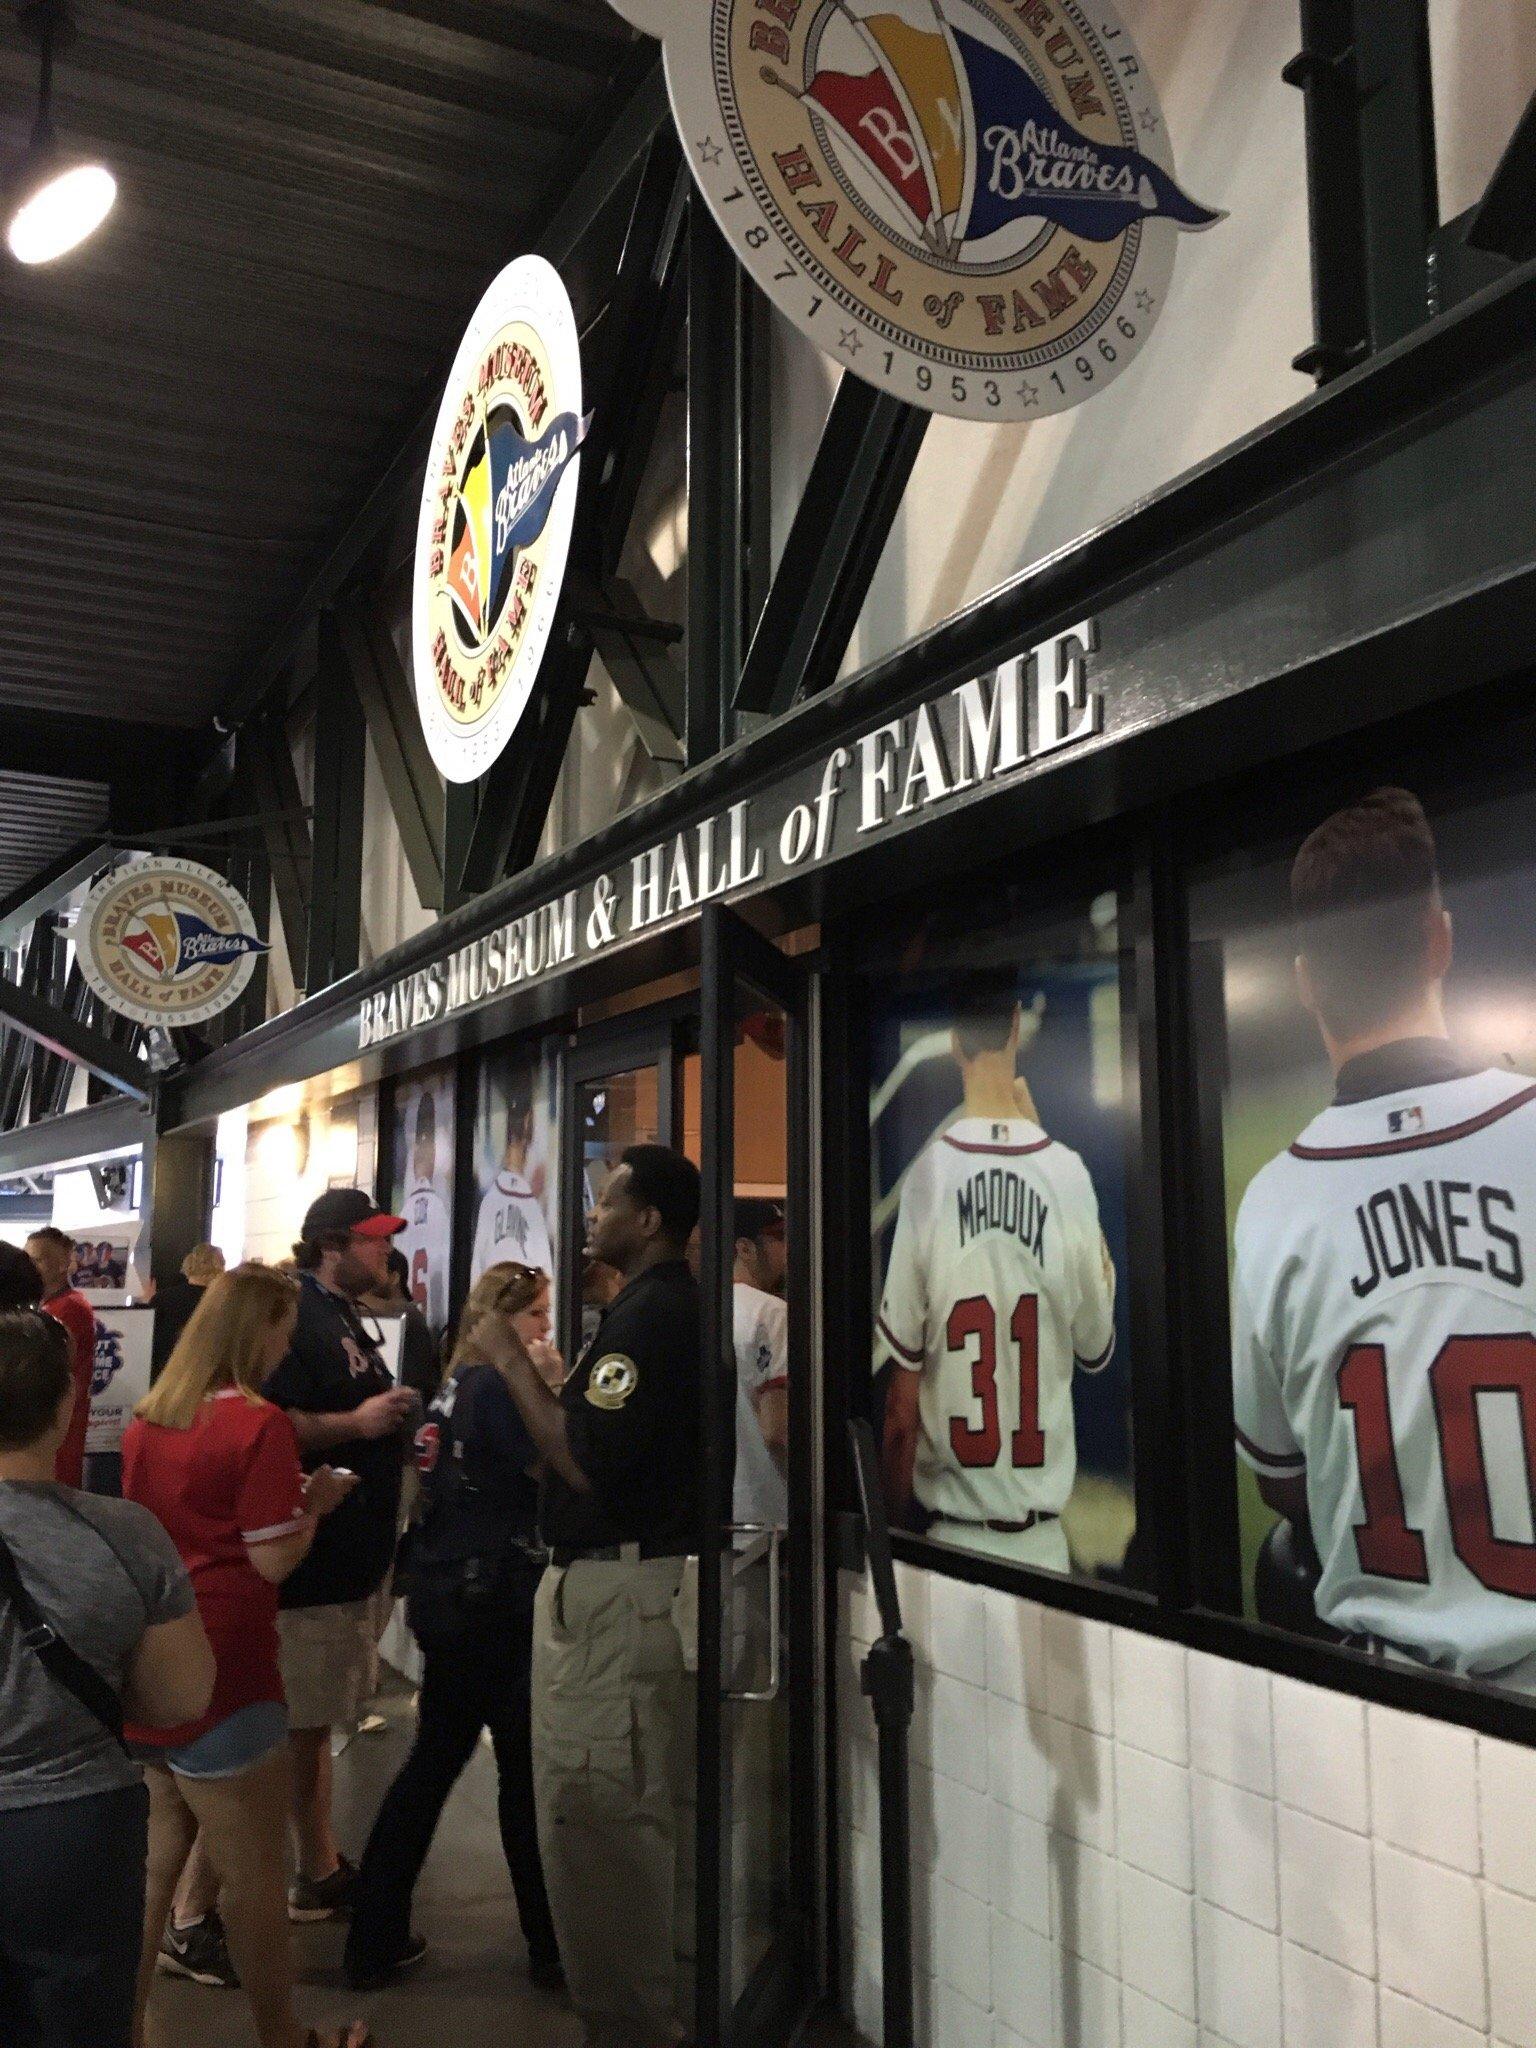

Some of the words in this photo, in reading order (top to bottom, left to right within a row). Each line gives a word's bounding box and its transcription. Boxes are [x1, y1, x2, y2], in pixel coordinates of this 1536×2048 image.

[859, 106, 922, 181] B
[983, 125, 1134, 200] Braves
[1021, 118, 1098, 164] Atlanta
[723, 186, 823, 317] 1871
[883, 351, 1001, 406] 1953
[1051, 315, 1136, 394] 1966
[771, 143, 904, 307] HALL
[923, 291, 965, 329] of
[976, 244, 1098, 335] FAME
[429, 391, 475, 578] BRAVES
[477, 341, 548, 430] MUSEUM
[431, 626, 466, 713] HALL
[486, 556, 538, 691] FAME
[459, 551, 478, 601] B
[358, 962, 445, 1049] BRAVES
[446, 889, 575, 1012] MUSEUM
[587, 874, 617, 950] &
[628, 800, 761, 932] HALL
[779, 747, 854, 866] of
[857, 619, 1097, 833] FAME
[102, 883, 154, 937] BRAVES
[161, 880, 230, 929] MUSEUM
[109, 959, 151, 999] HALL
[180, 967, 224, 999] FAME
[957, 1166, 1048, 1268] MADDUX
[1351, 1179, 1525, 1298] JONES
[946, 1293, 1046, 1469] 31
[1337, 1331, 1536, 1601] 10
